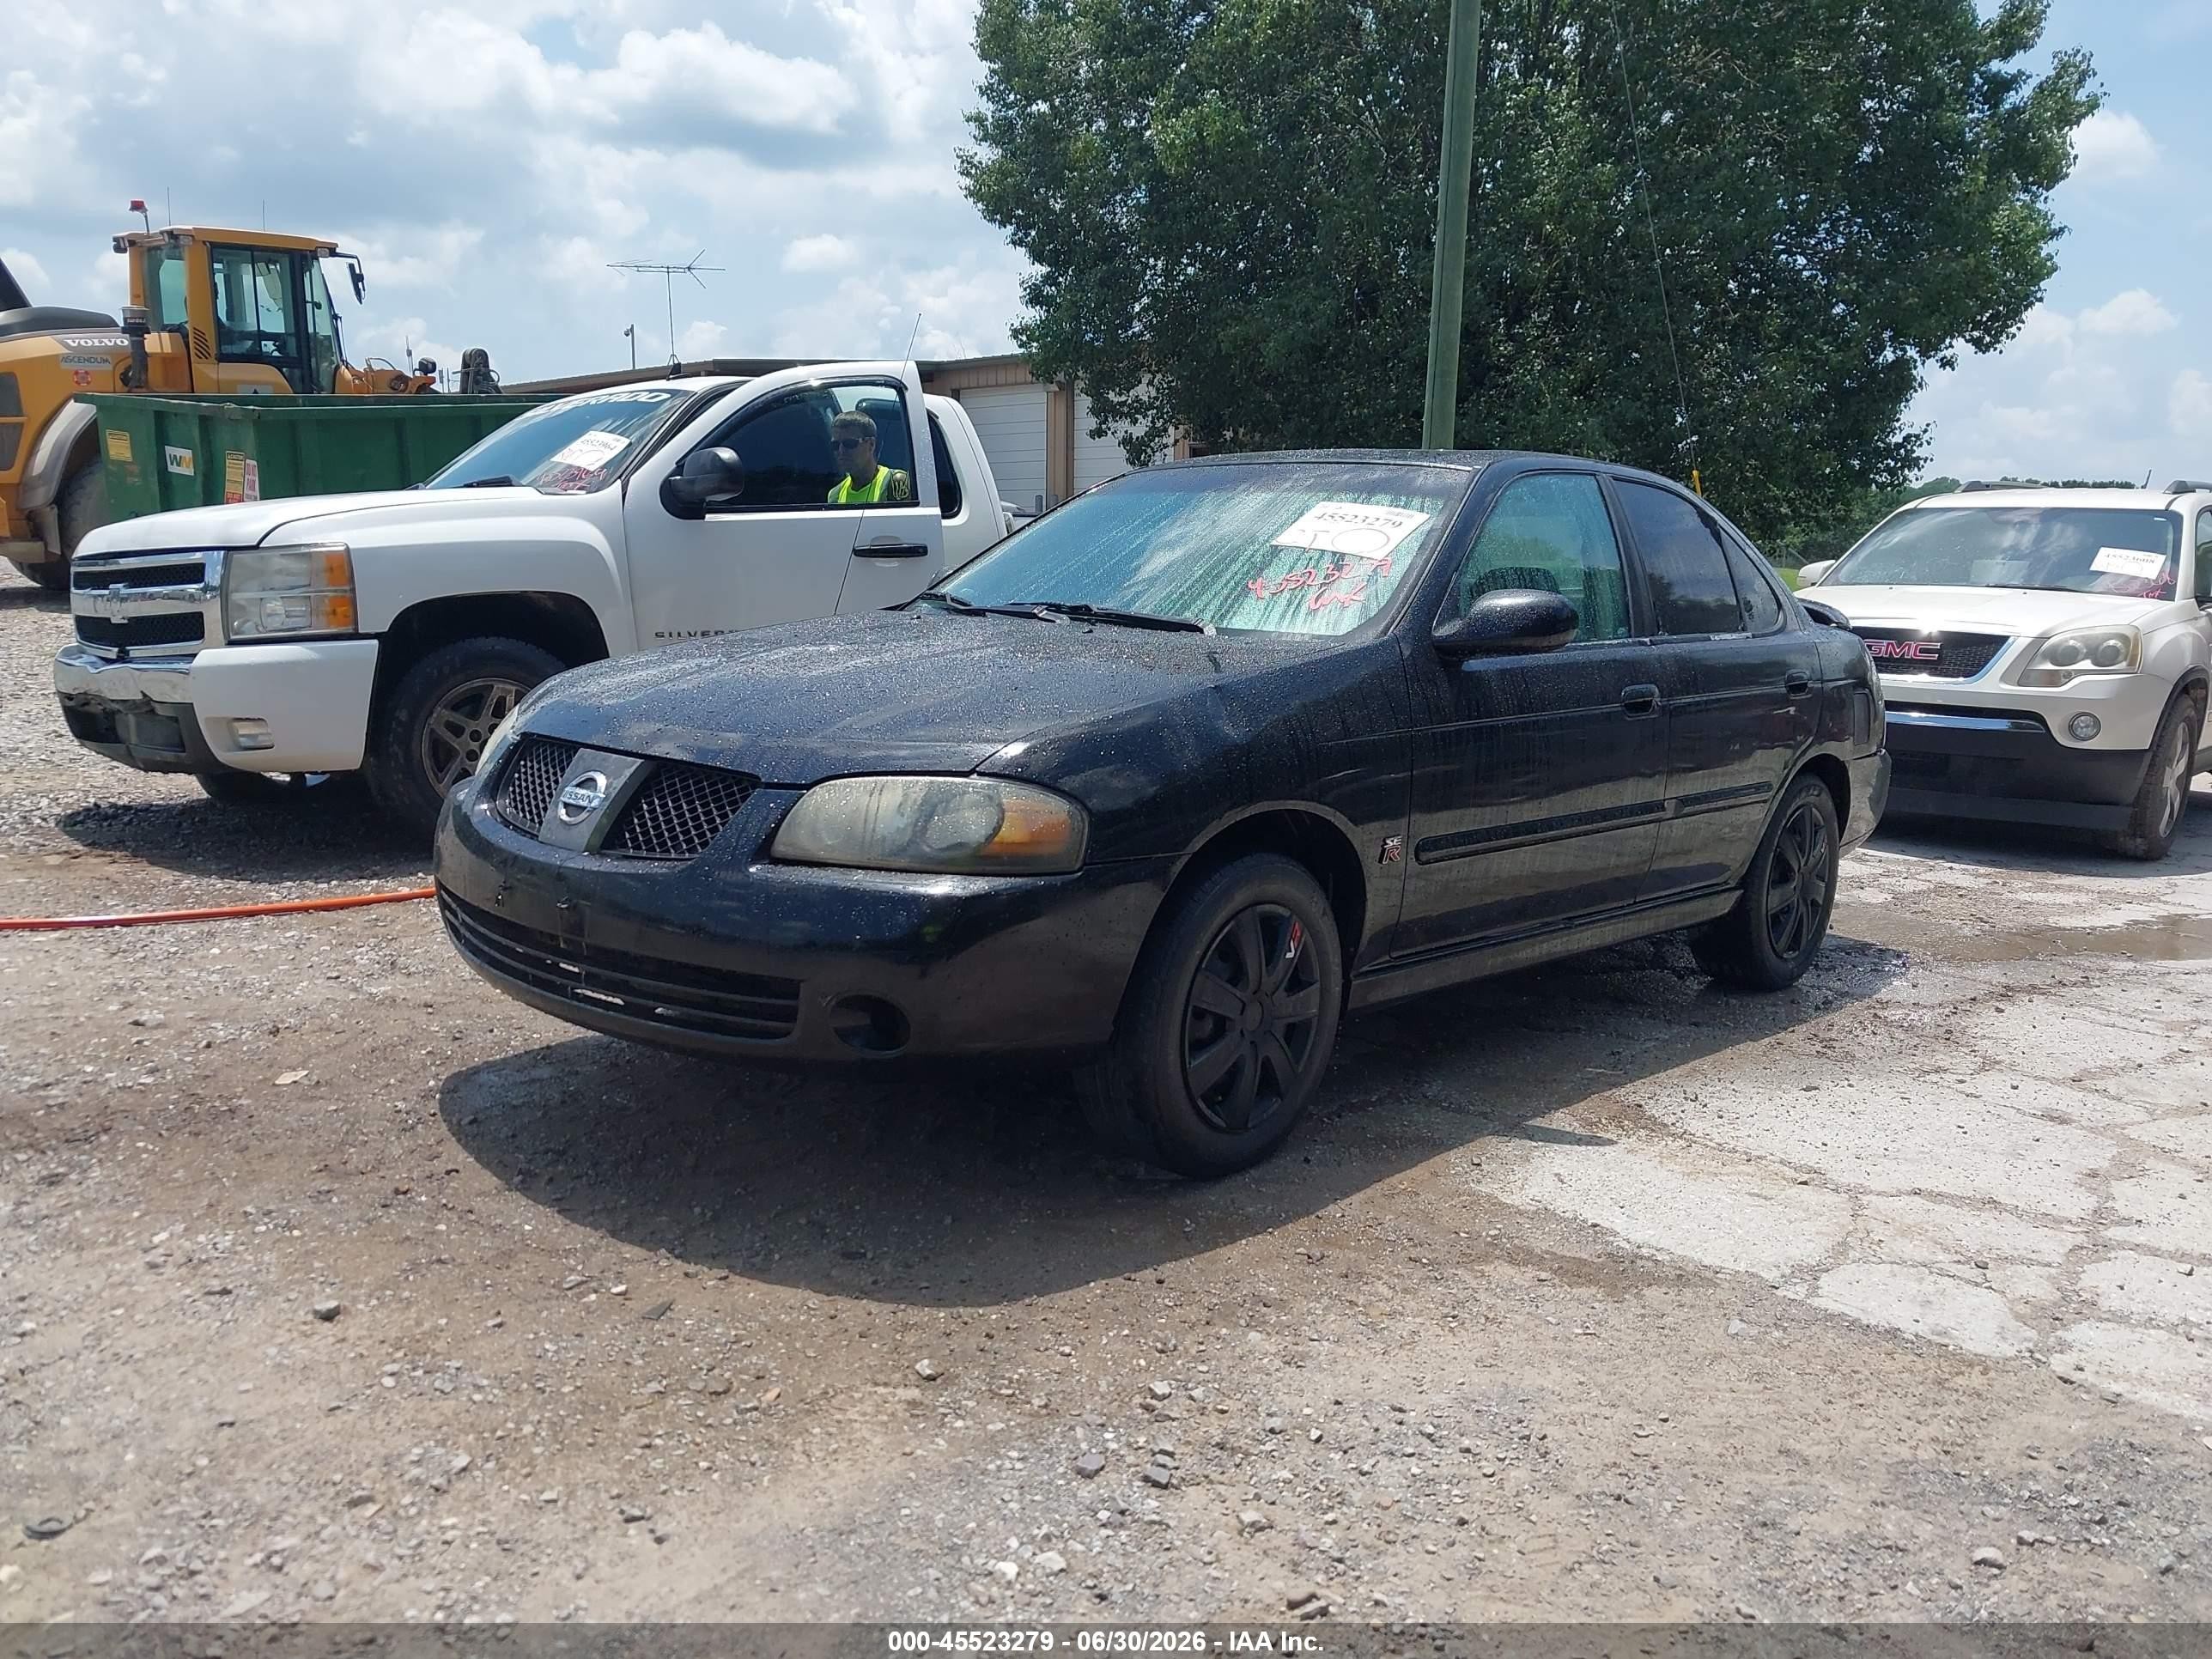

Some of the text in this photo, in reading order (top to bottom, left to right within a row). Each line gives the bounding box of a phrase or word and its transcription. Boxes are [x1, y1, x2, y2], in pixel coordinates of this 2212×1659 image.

[64, 337, 129, 347] VOLVO
[1314, 513, 1403, 528] 45523279
[1863, 638, 1943, 660] GMC
[1383, 835, 1403, 848] SE
[1382, 845, 1401, 865] R
